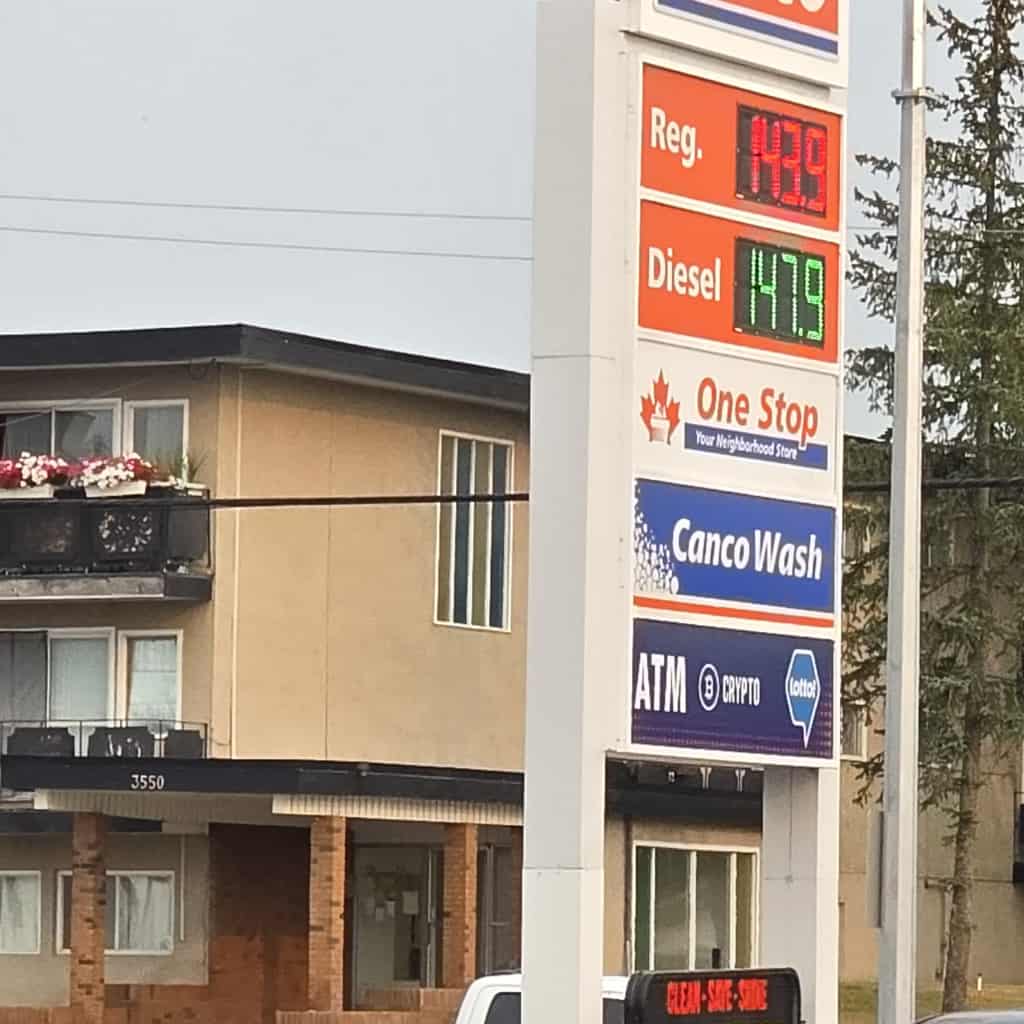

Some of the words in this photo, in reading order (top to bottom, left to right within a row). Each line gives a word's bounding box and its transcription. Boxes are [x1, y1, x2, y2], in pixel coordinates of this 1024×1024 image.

[650, 106, 703, 169] Reg.
[647, 247, 722, 302] Diesel
[751, 248, 824, 342] 147.9
[697, 376, 750, 426] One
[757, 386, 819, 447] Stop
[695, 430, 716, 447] Your
[716, 433, 775, 454] Neighborhood
[775, 443, 798, 460] Store
[672, 517, 750, 570] Canco
[753, 528, 823, 580] Wash
[633, 652, 688, 714] ATM
[722, 675, 761, 707] CRYPTO
[130, 774, 165, 790] 3550
